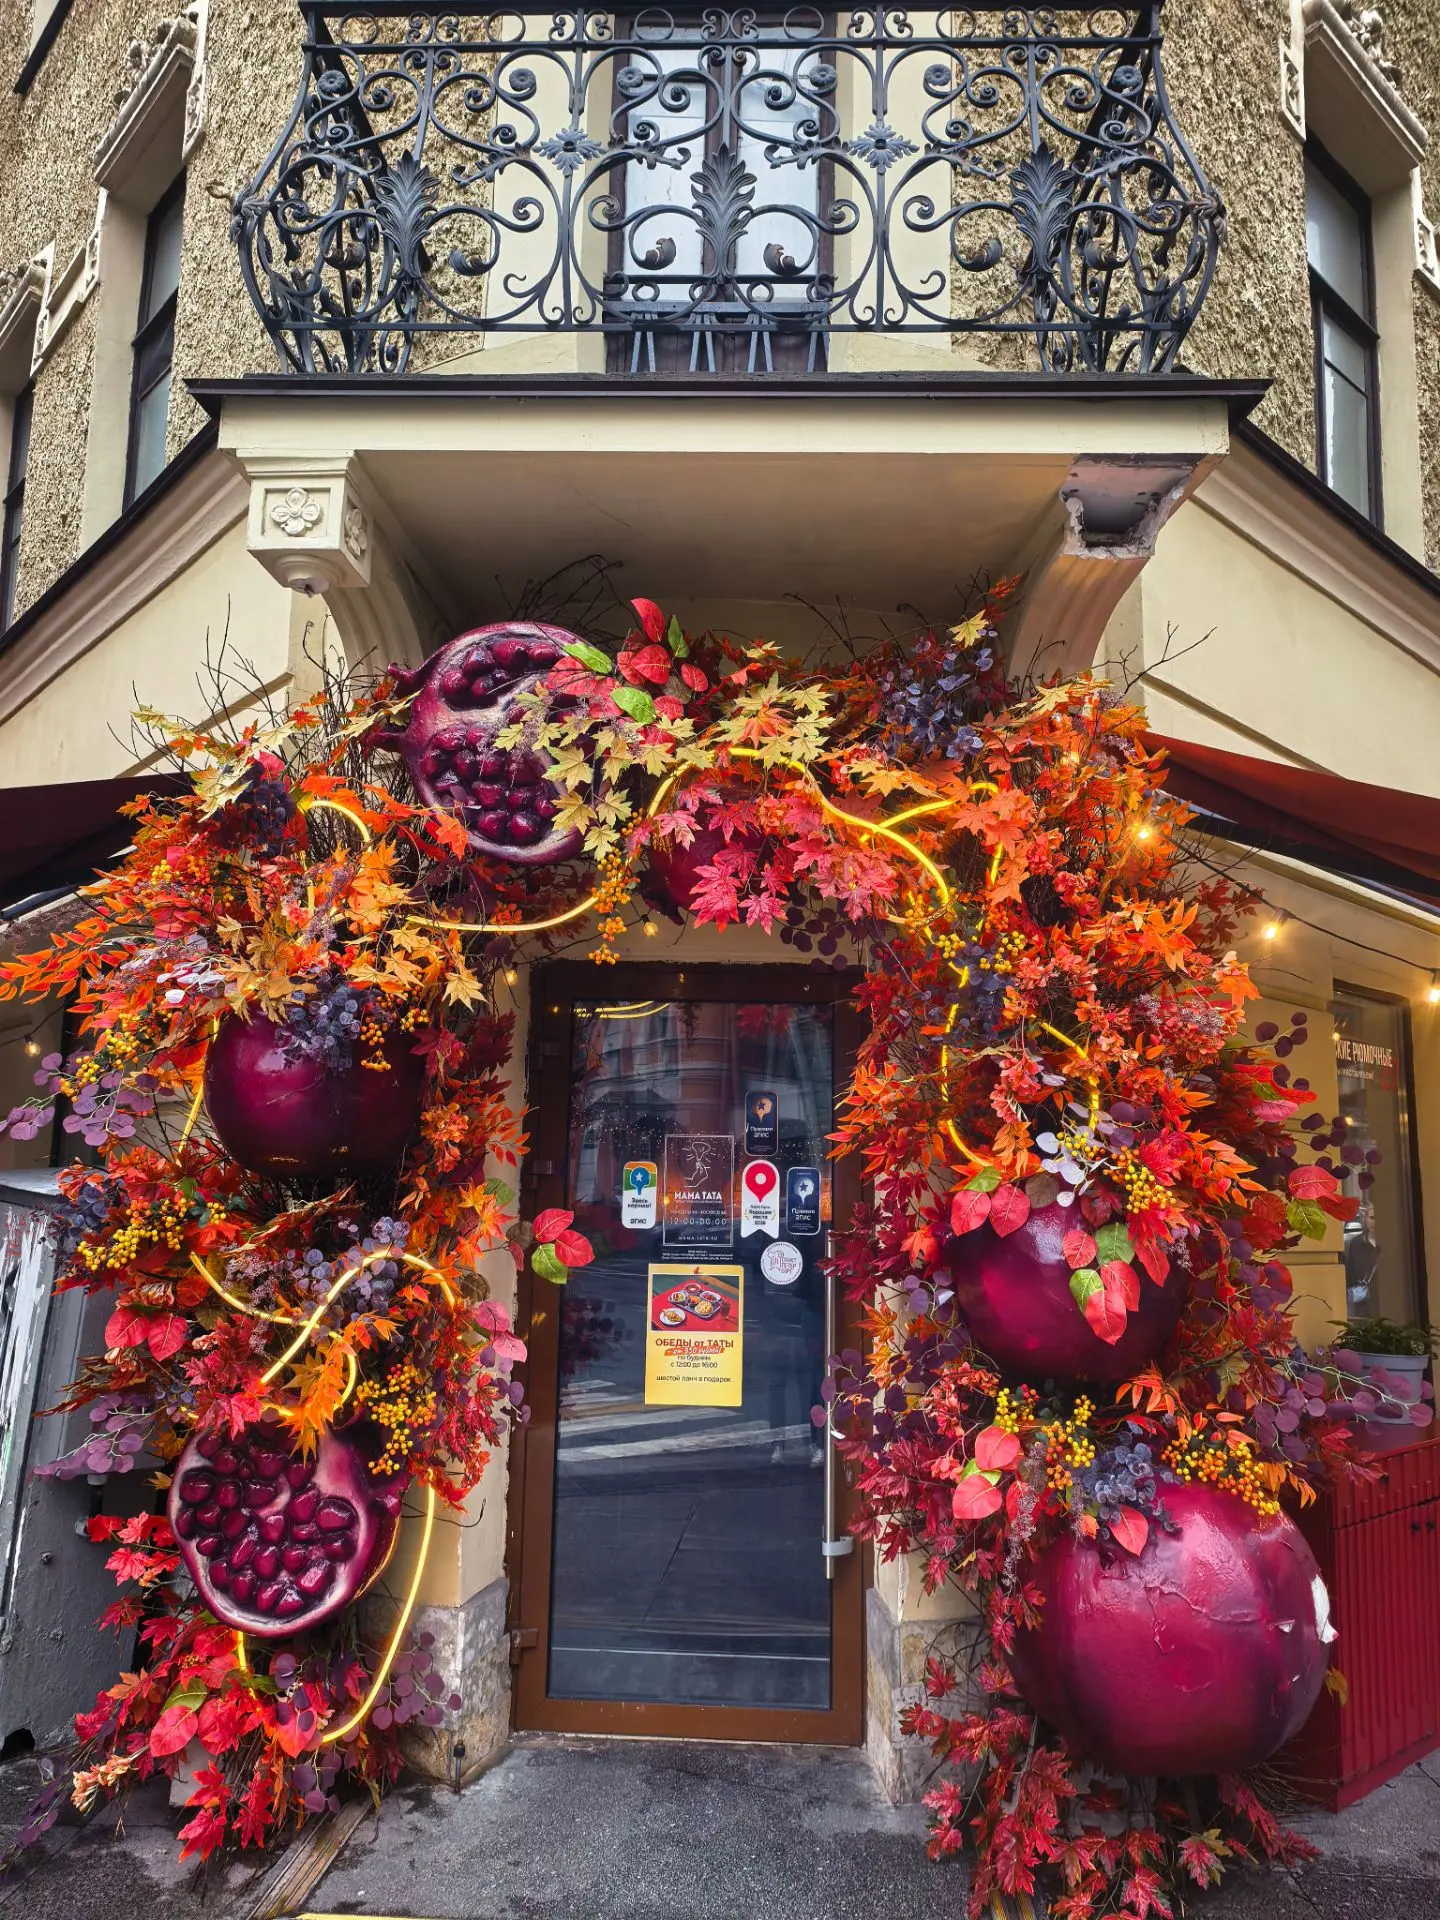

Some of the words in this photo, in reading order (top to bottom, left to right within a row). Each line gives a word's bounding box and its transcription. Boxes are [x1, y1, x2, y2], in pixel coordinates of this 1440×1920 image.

[1352, 1042, 1393, 1067] РЮМОЧНЫЕ
[674, 1191, 701, 1200] МАМА
[702, 1191, 722, 1200] ТАТА
[655, 1338, 691, 1348] ОБЕДЫ
[708, 1339, 734, 1348] ТАТЫ
[703, 1376, 732, 1384] подарок
